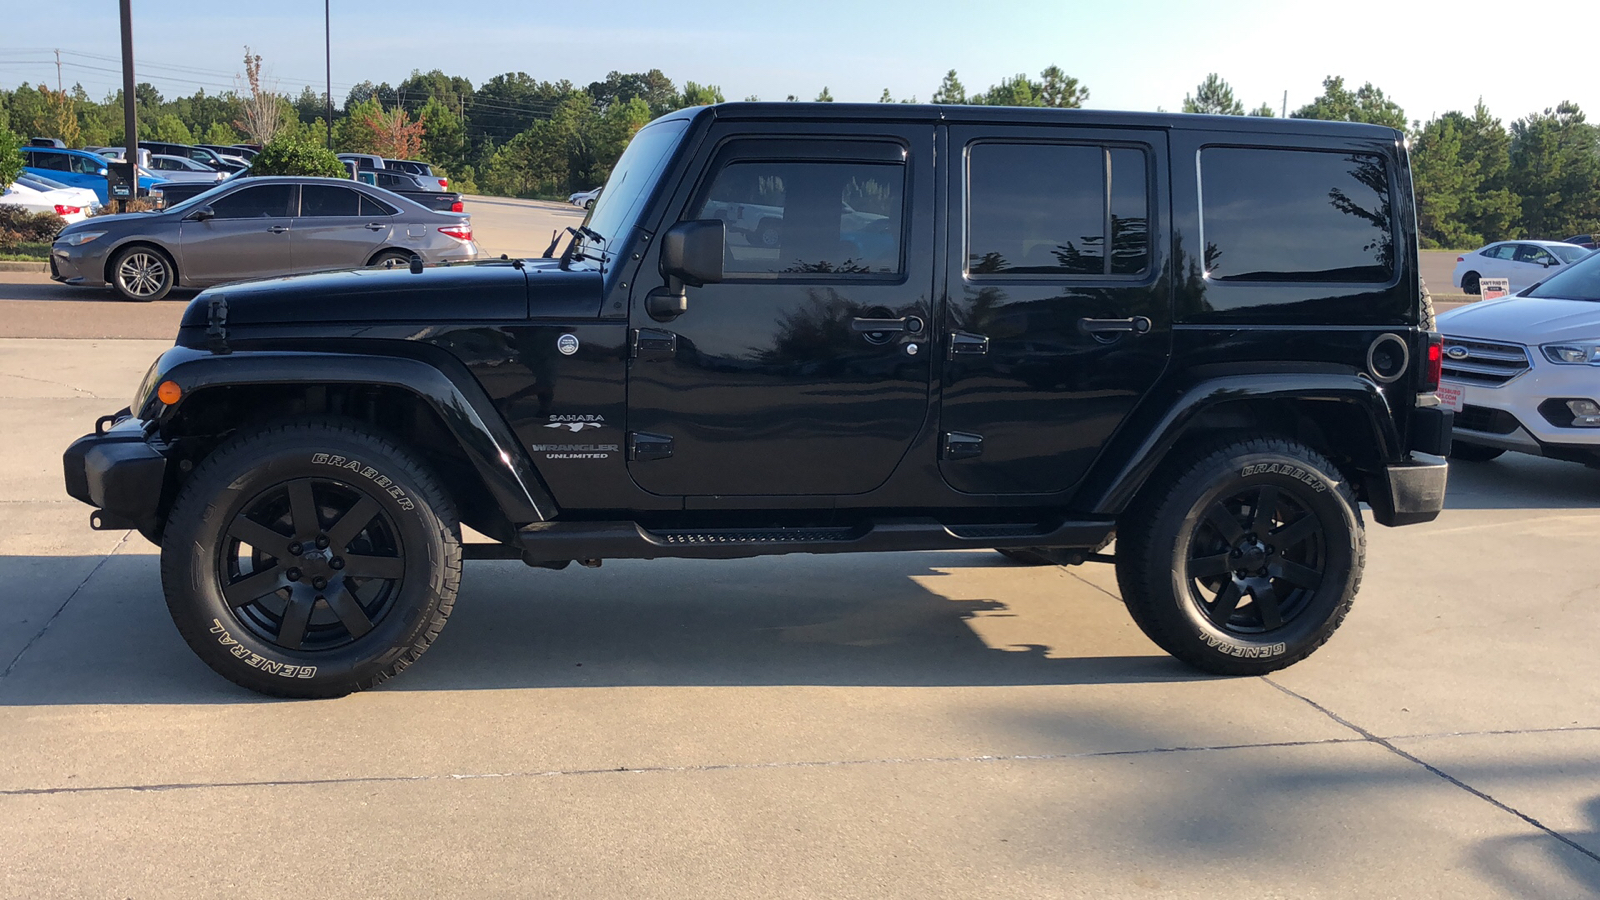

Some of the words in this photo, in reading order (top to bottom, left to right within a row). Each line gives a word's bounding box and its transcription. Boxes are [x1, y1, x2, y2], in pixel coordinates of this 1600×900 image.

[549, 414, 605, 422] SAHARA
[532, 444, 619, 452] WRANGLER
[311, 452, 415, 511] GRABBER
[1241, 463, 1327, 493] GRABBER
[209, 618, 318, 679] GENERAL
[1198, 627, 1286, 658] GENERAL
